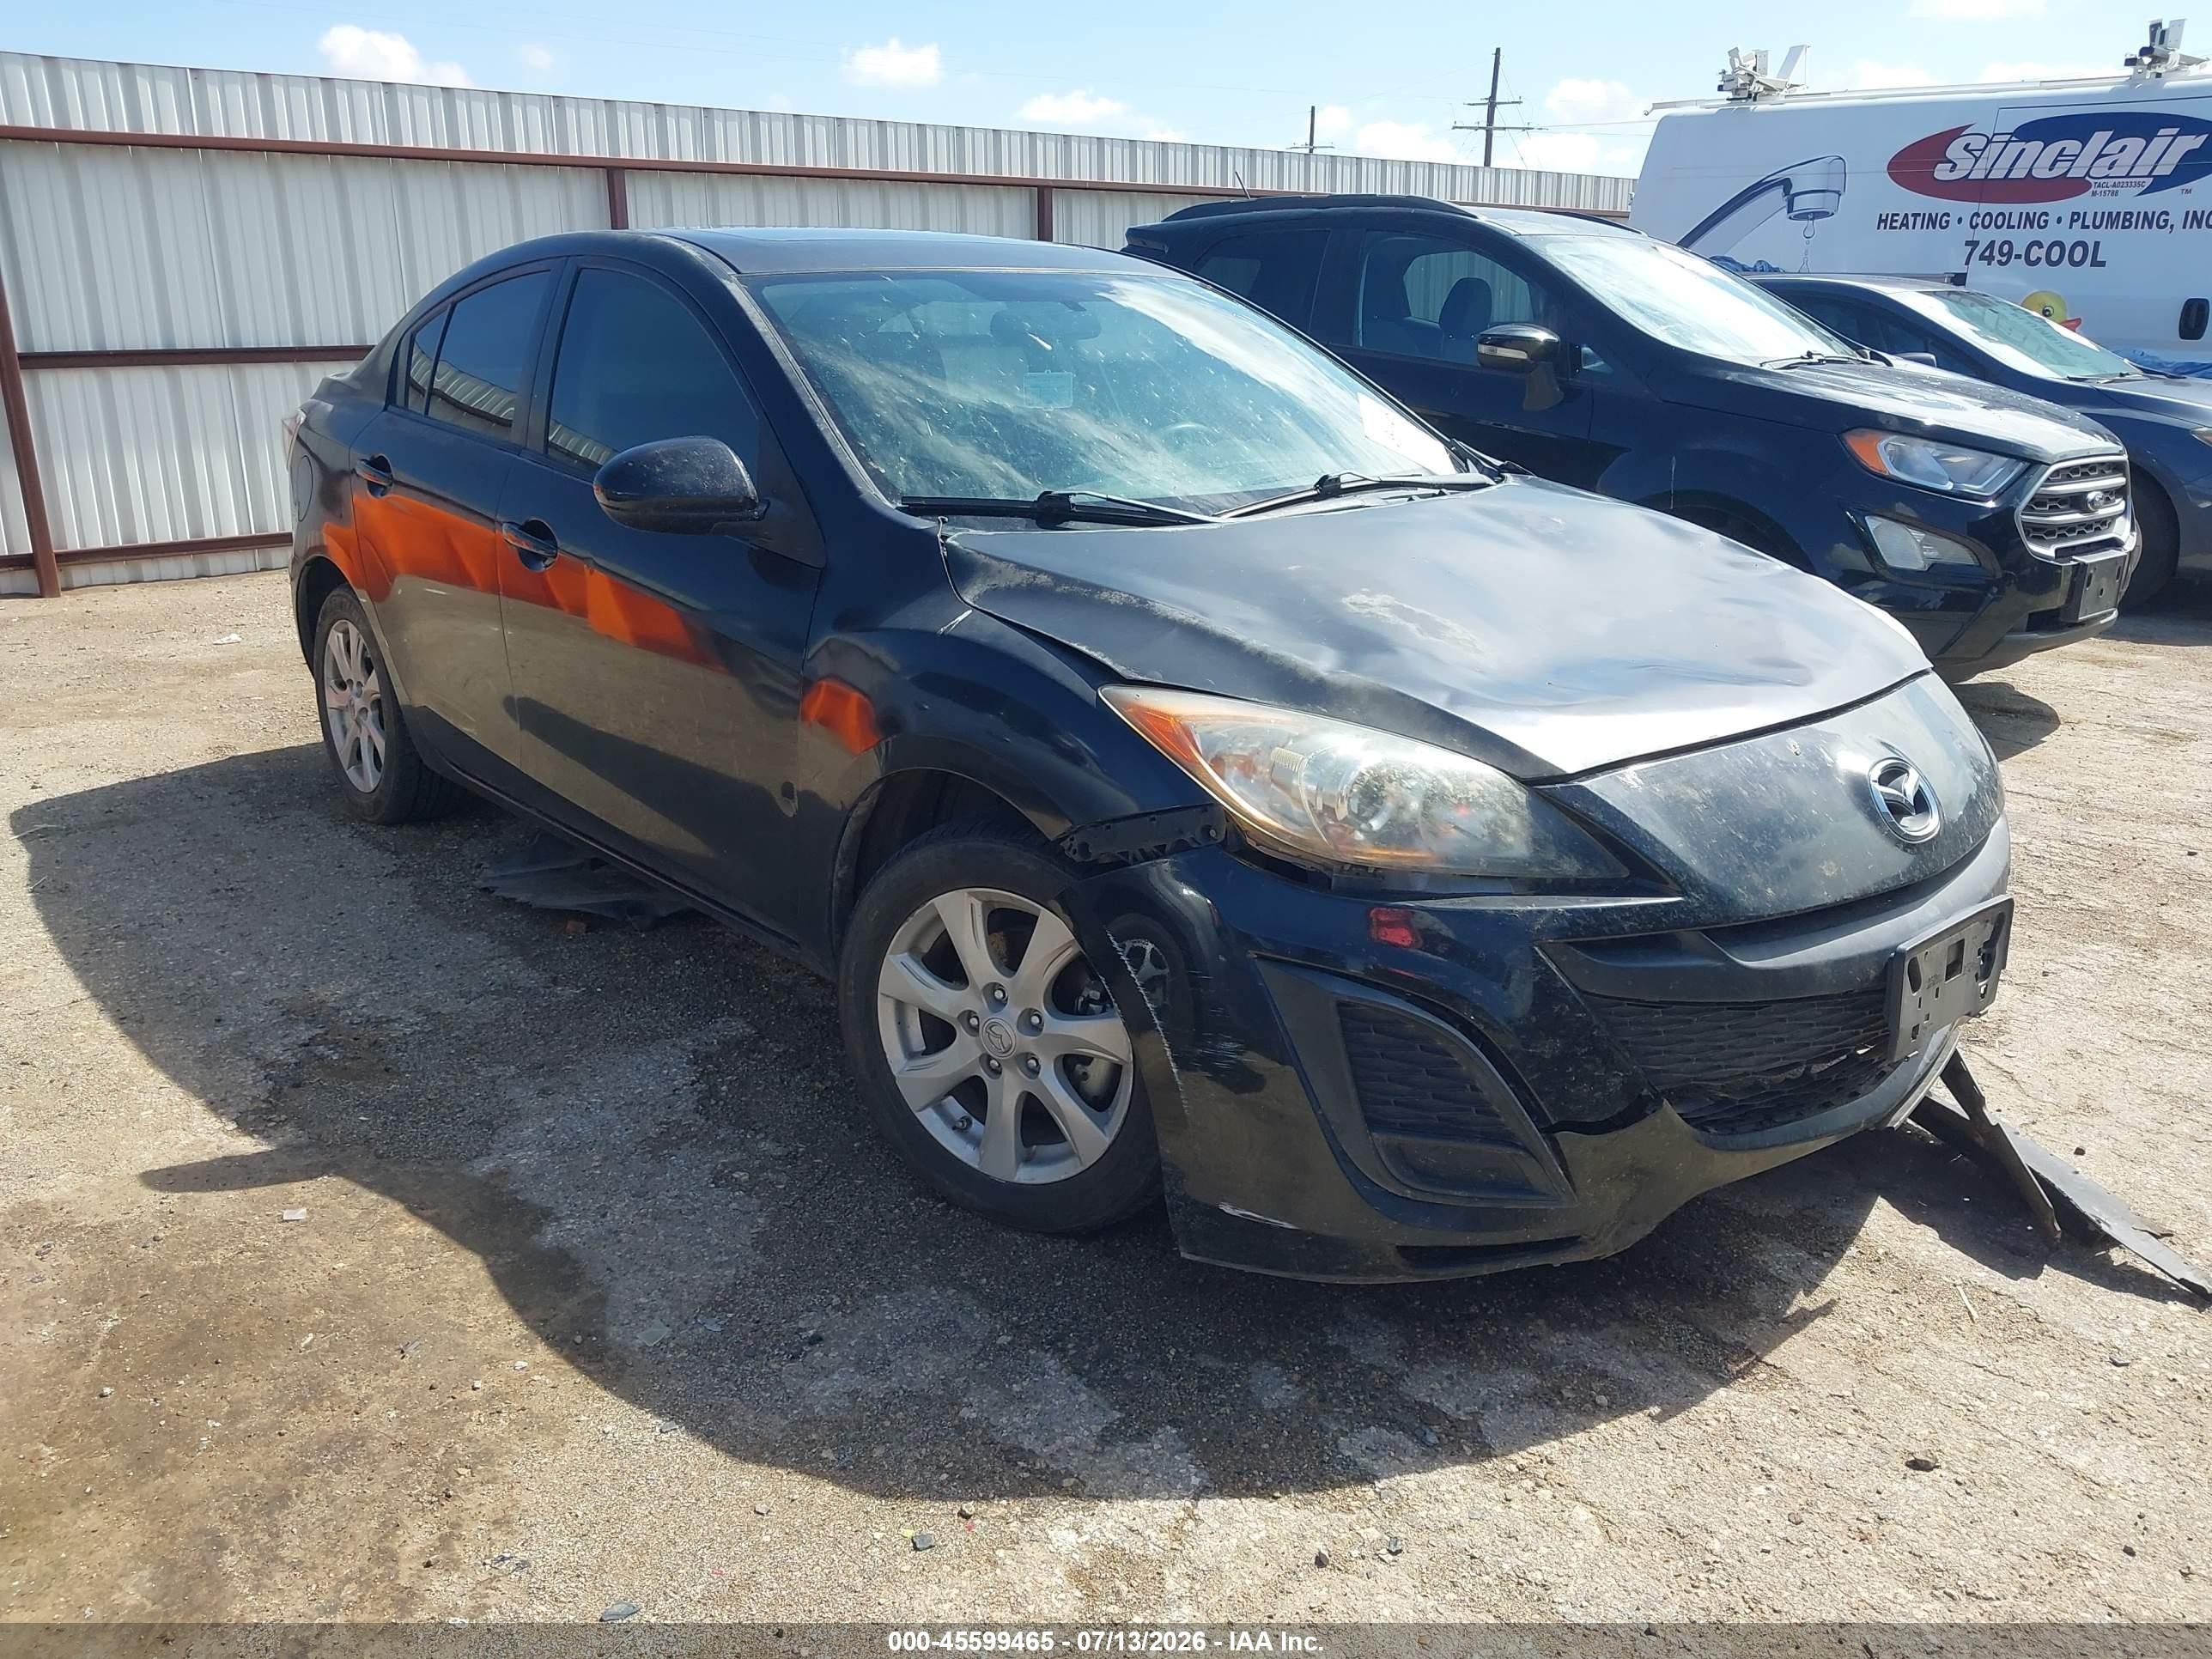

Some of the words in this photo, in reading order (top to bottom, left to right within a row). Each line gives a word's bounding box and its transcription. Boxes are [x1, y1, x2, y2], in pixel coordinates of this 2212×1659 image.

[1933, 128, 2209, 182] Sinclair
[2094, 180, 2146, 189] TACL-A023335C
[1876, 212, 1951, 230] HEATING
[1969, 211, 2050, 230] COOLING
[2068, 210, 2175, 234] PLUMBING,
[1964, 240, 2107, 268] 749-COOL
